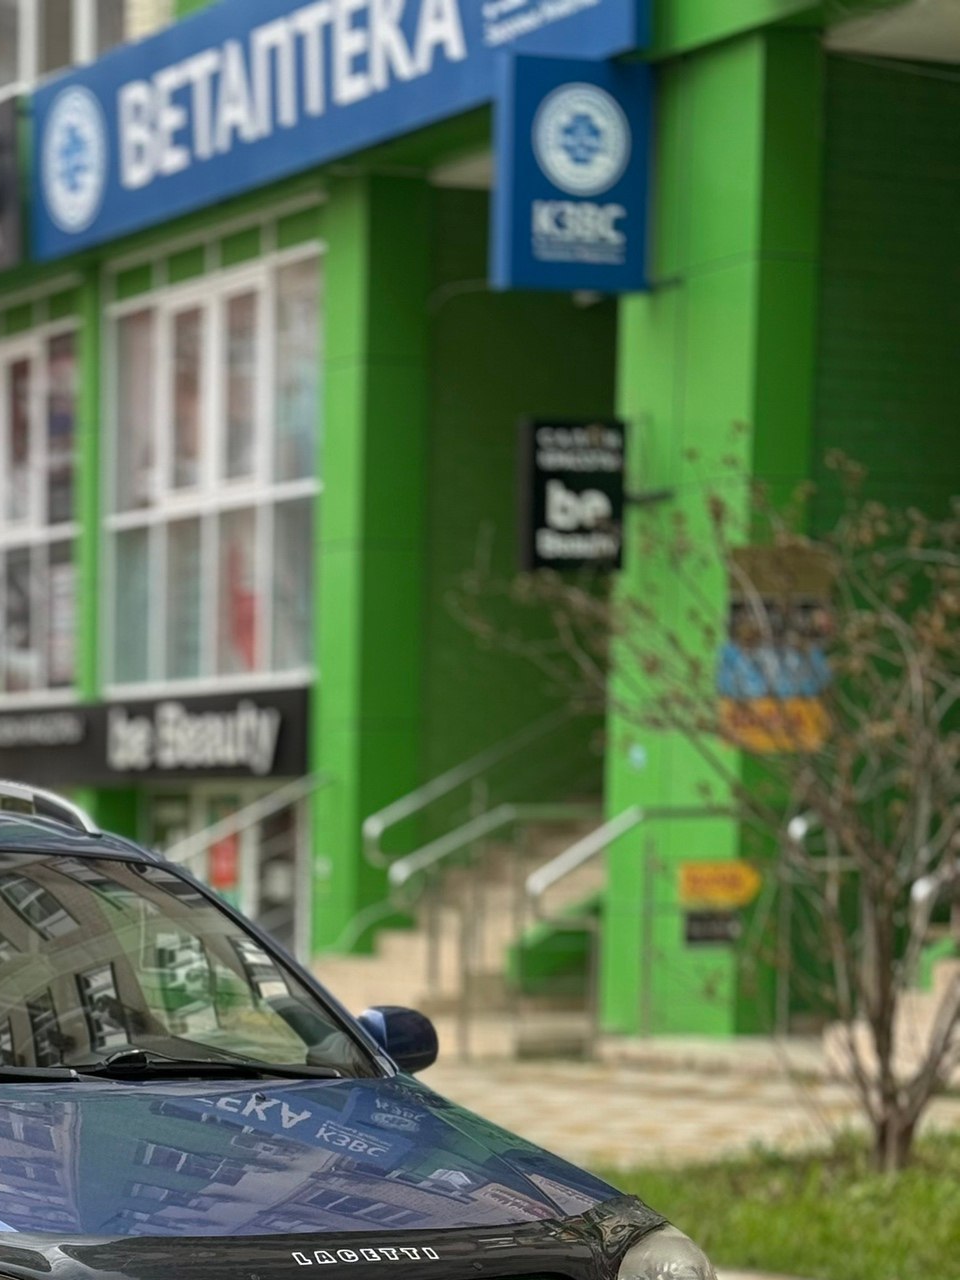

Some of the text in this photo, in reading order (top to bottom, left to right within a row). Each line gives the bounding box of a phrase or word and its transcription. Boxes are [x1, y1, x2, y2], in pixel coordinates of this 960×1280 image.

[116, 0, 468, 191] ВЕТАПТЕКА
[155, 700, 281, 776] Beauty
[292, 1247, 440, 1266] LACETTI
